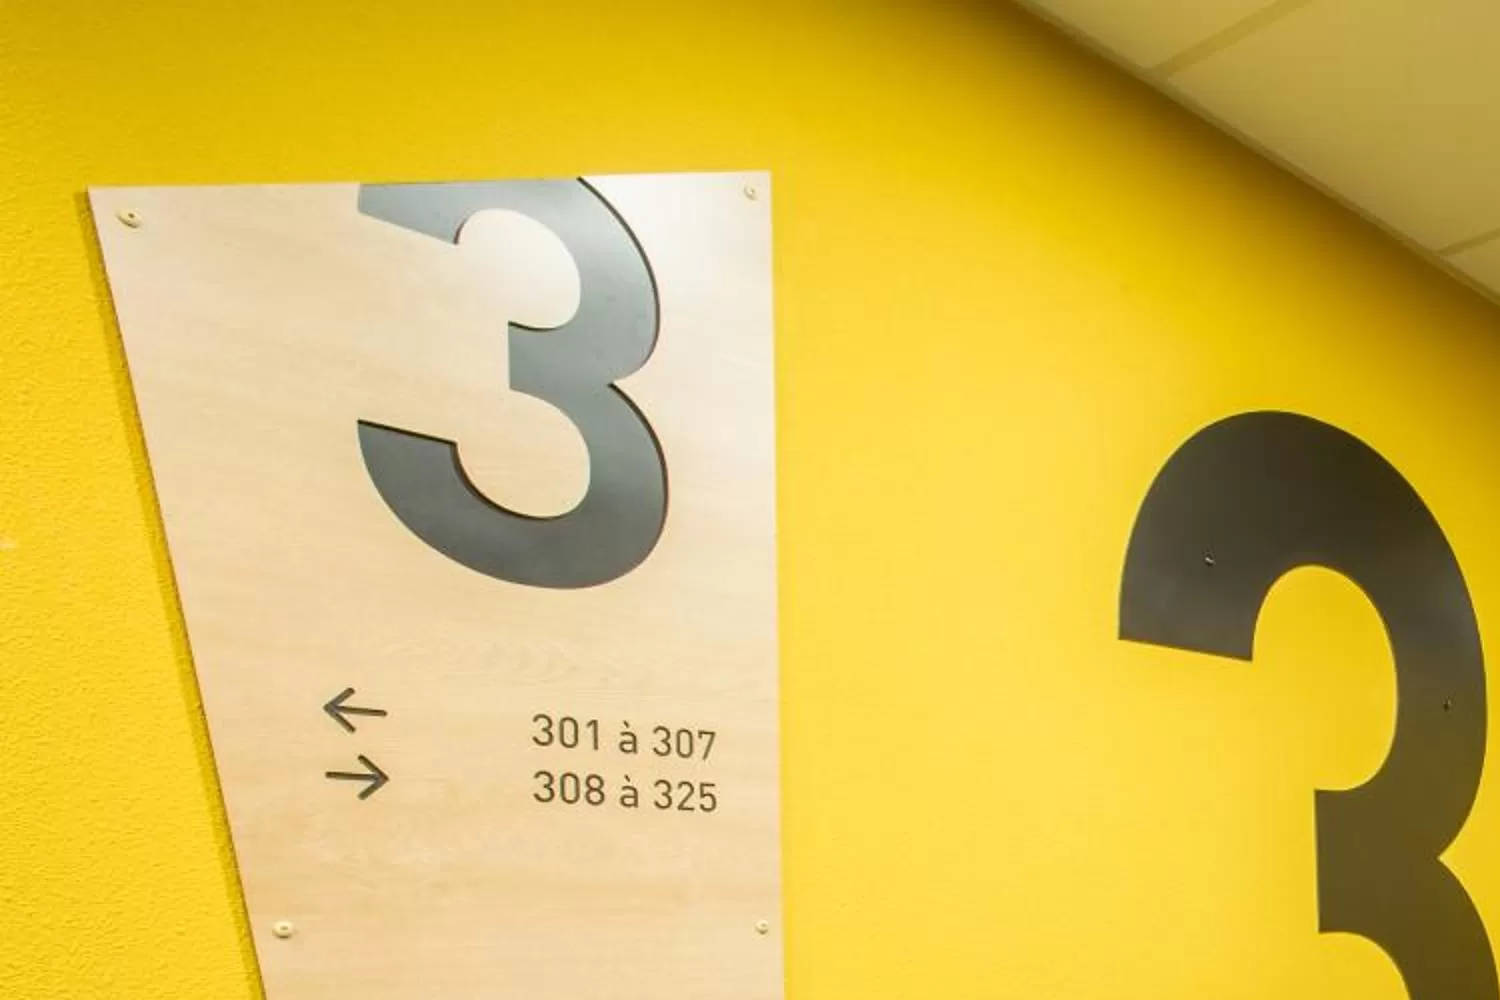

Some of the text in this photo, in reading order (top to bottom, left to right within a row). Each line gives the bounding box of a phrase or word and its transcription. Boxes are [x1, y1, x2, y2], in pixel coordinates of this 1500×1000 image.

[357, 177, 669, 590] 3
[532, 713, 716, 761] 301 à 307
[532, 770, 717, 812] 308 à 325
